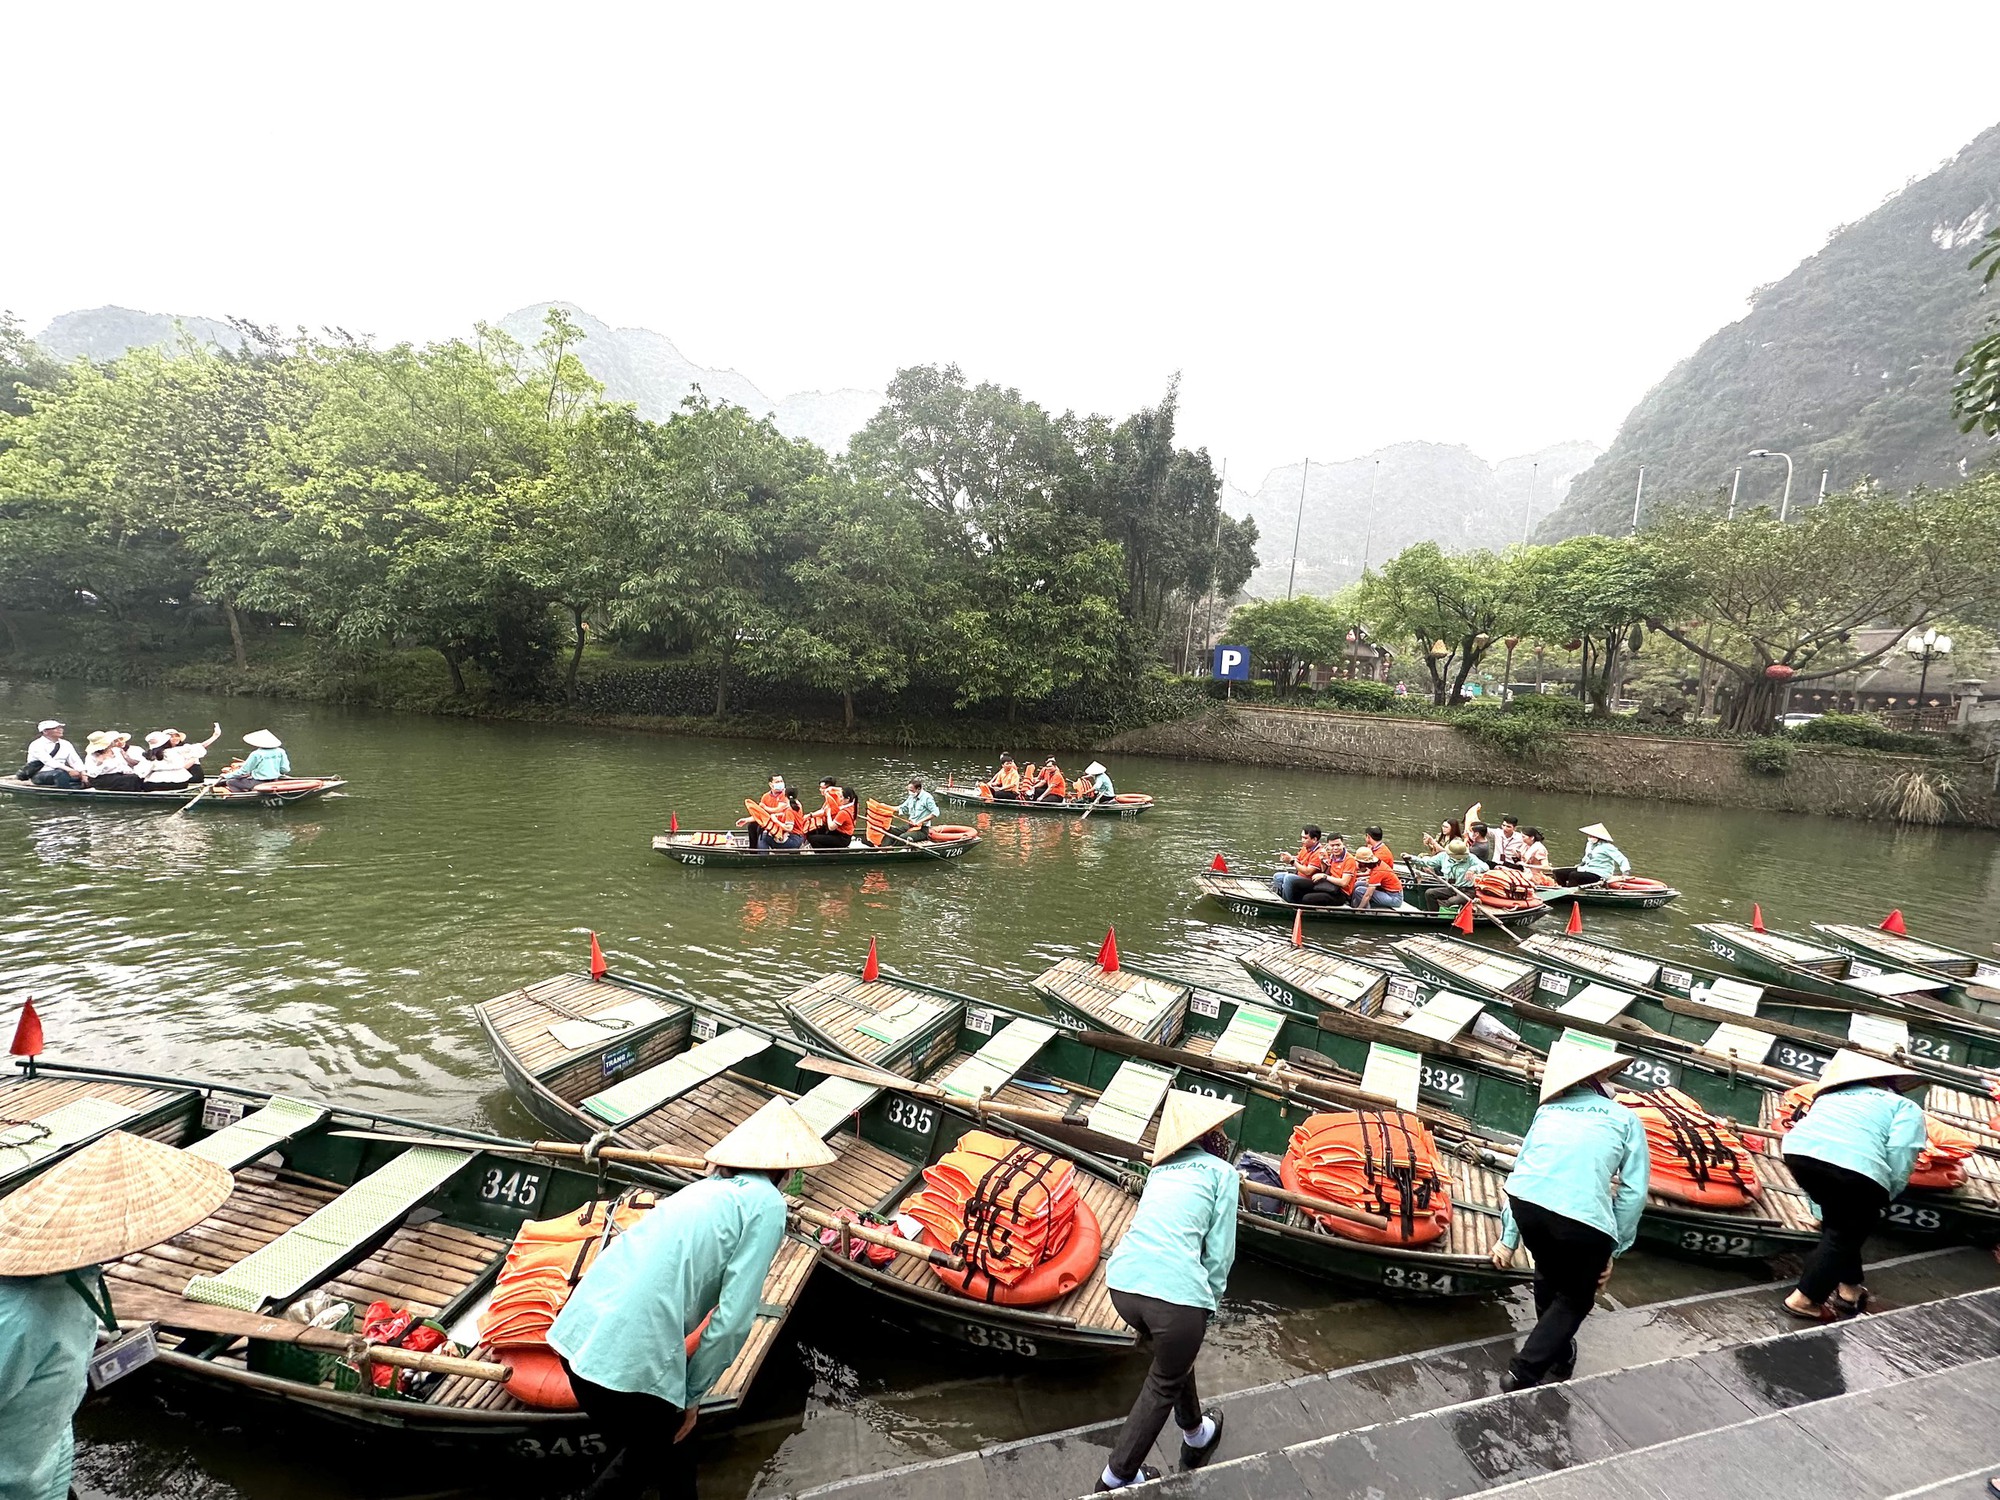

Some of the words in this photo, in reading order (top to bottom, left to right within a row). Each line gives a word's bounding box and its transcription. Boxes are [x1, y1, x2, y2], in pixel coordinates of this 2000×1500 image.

[1221, 650, 1242, 675] P
[681, 853, 705, 865] 726
[945, 847, 964, 858] 726
[1231, 902, 1259, 916] 303
[1710, 939, 1736, 962] 322
[1263, 979, 1294, 1007] 328
[1907, 1035, 1951, 1061] 24
[1420, 1065, 1465, 1098] 332
[889, 1098, 933, 1134] 335
[482, 1168, 540, 1205] 345
[1680, 1231, 1752, 1258] 332
[1383, 1266, 1453, 1295] 334
[967, 1324, 1038, 1357] 335
[516, 1433, 608, 1458] 345
